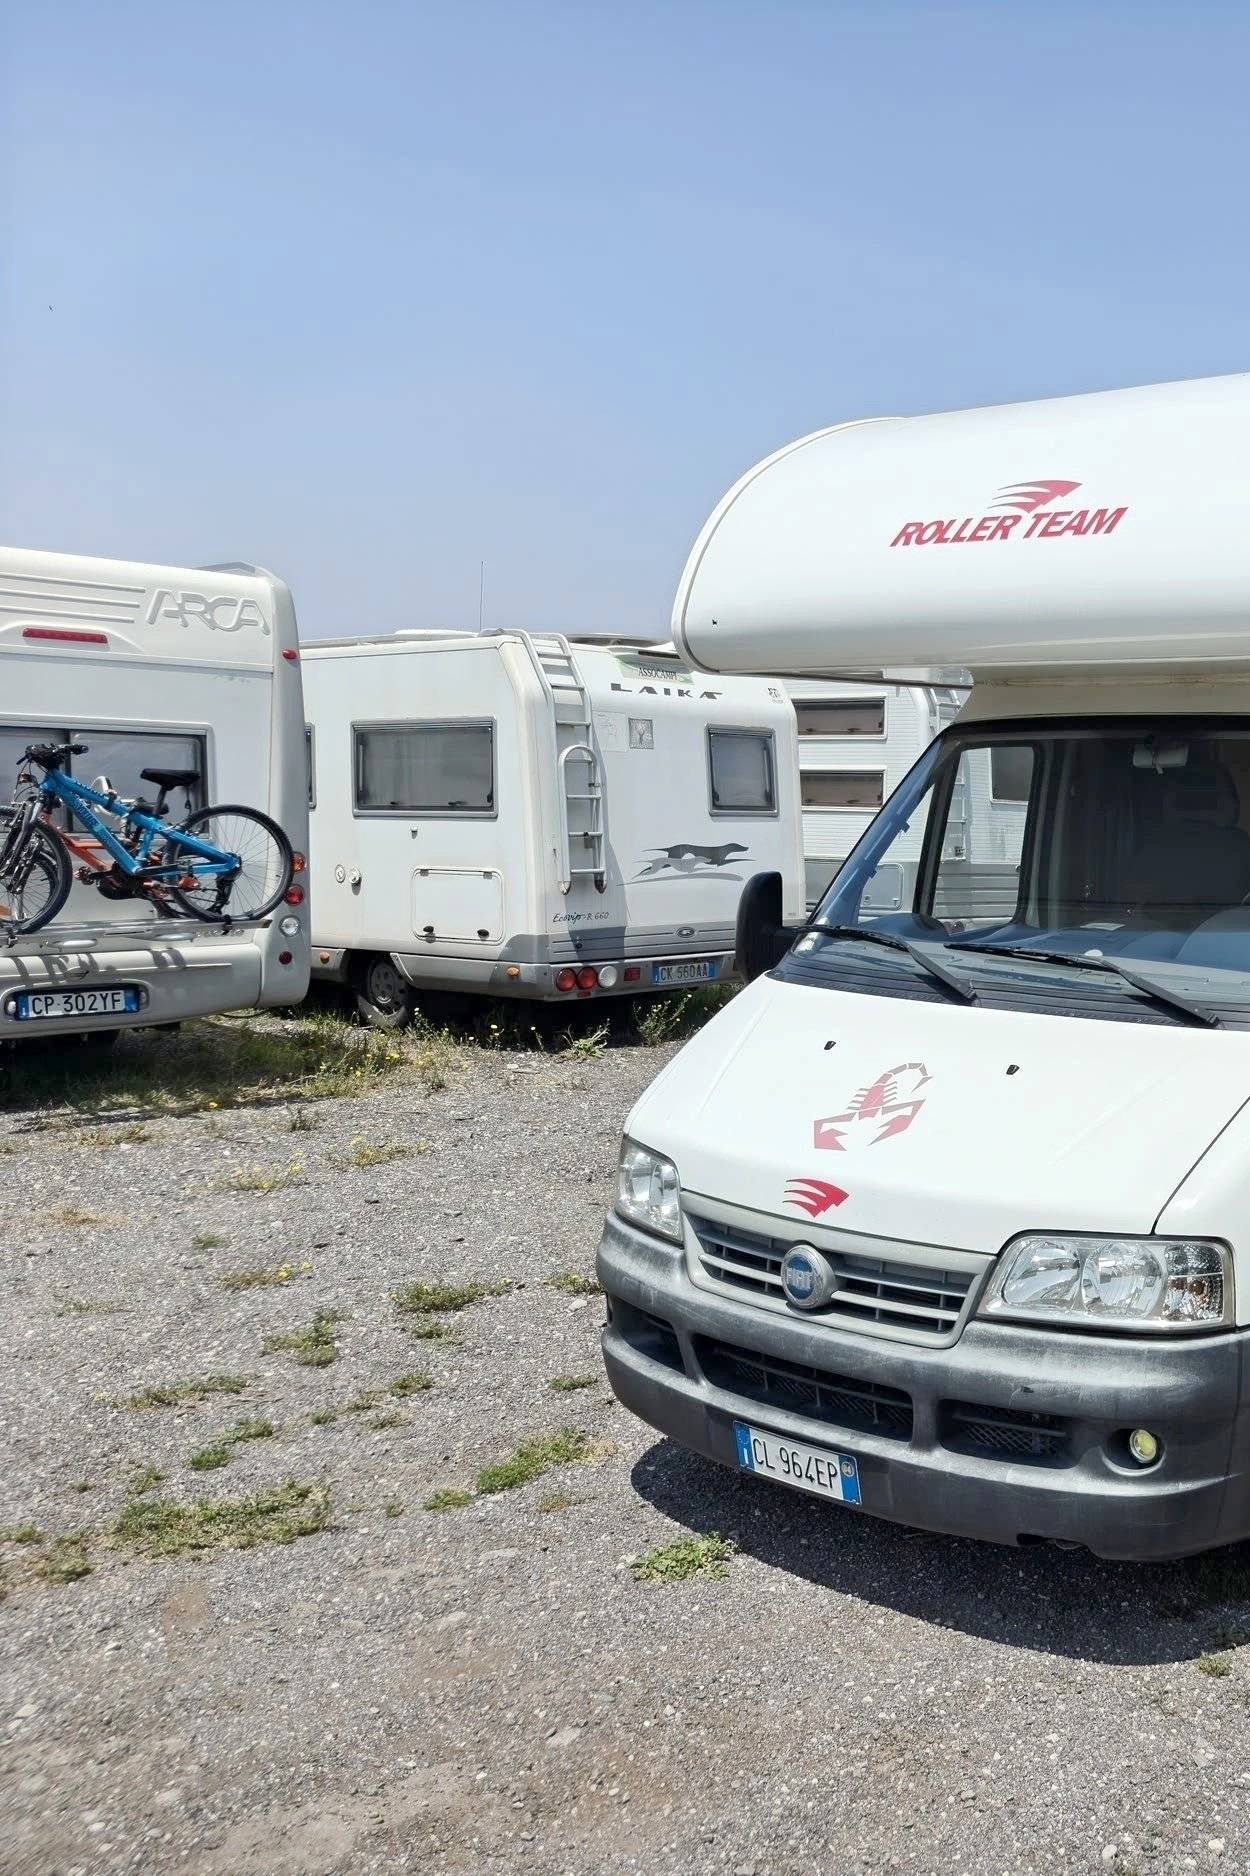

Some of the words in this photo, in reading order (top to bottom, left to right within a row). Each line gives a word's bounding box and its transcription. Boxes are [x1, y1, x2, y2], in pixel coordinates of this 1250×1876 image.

[890, 514, 1022, 547] ROLLER
[1023, 506, 1129, 539] TEAM
[146, 589, 271, 636] ARCA
[610, 682, 723, 700] LAIKA
[660, 967, 673, 981] CK
[31, 996, 54, 1015] CP
[62, 992, 121, 1012] 302YF
[753, 1438, 776, 1470] CL
[779, 1446, 838, 1489] 964EP
